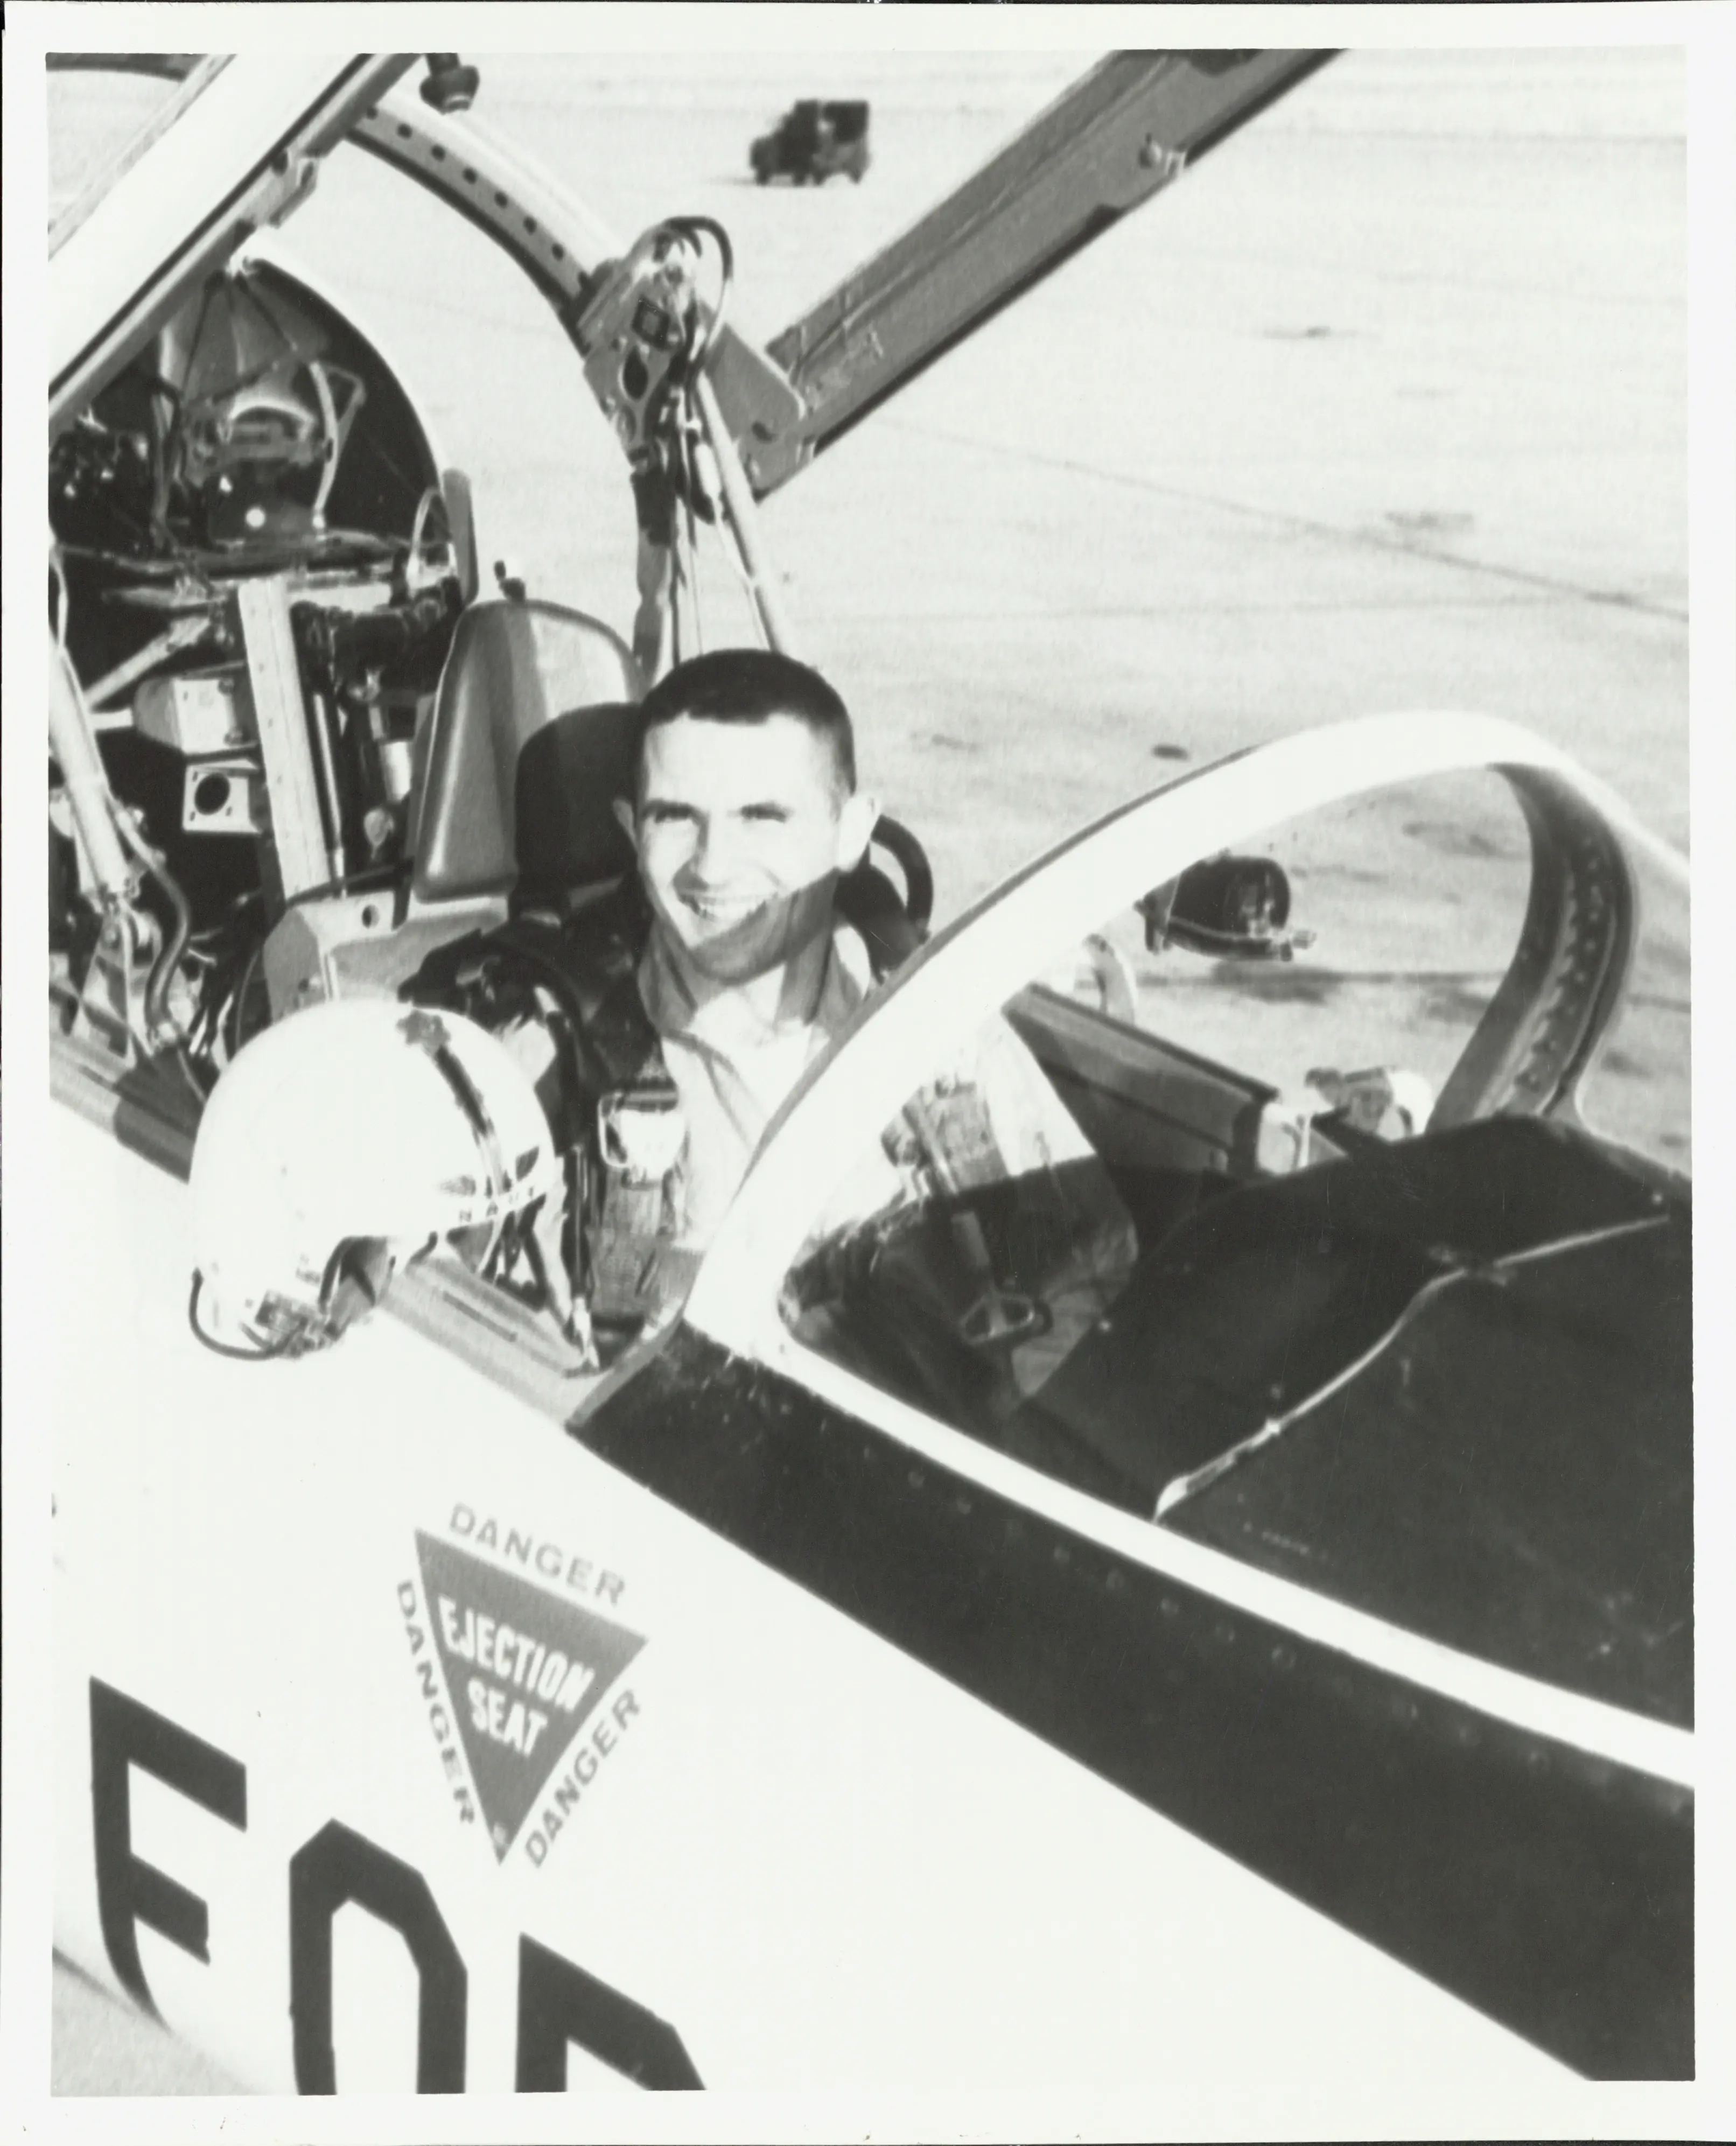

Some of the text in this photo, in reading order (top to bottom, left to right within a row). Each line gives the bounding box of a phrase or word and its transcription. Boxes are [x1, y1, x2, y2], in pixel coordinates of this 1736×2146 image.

[449, 1503, 626, 1606] DANGER
[396, 1579, 476, 1824] DANGER
[437, 1594, 596, 1715] EJECTION
[466, 1676, 549, 1757] SEAT
[524, 1688, 641, 1869] DANGER
